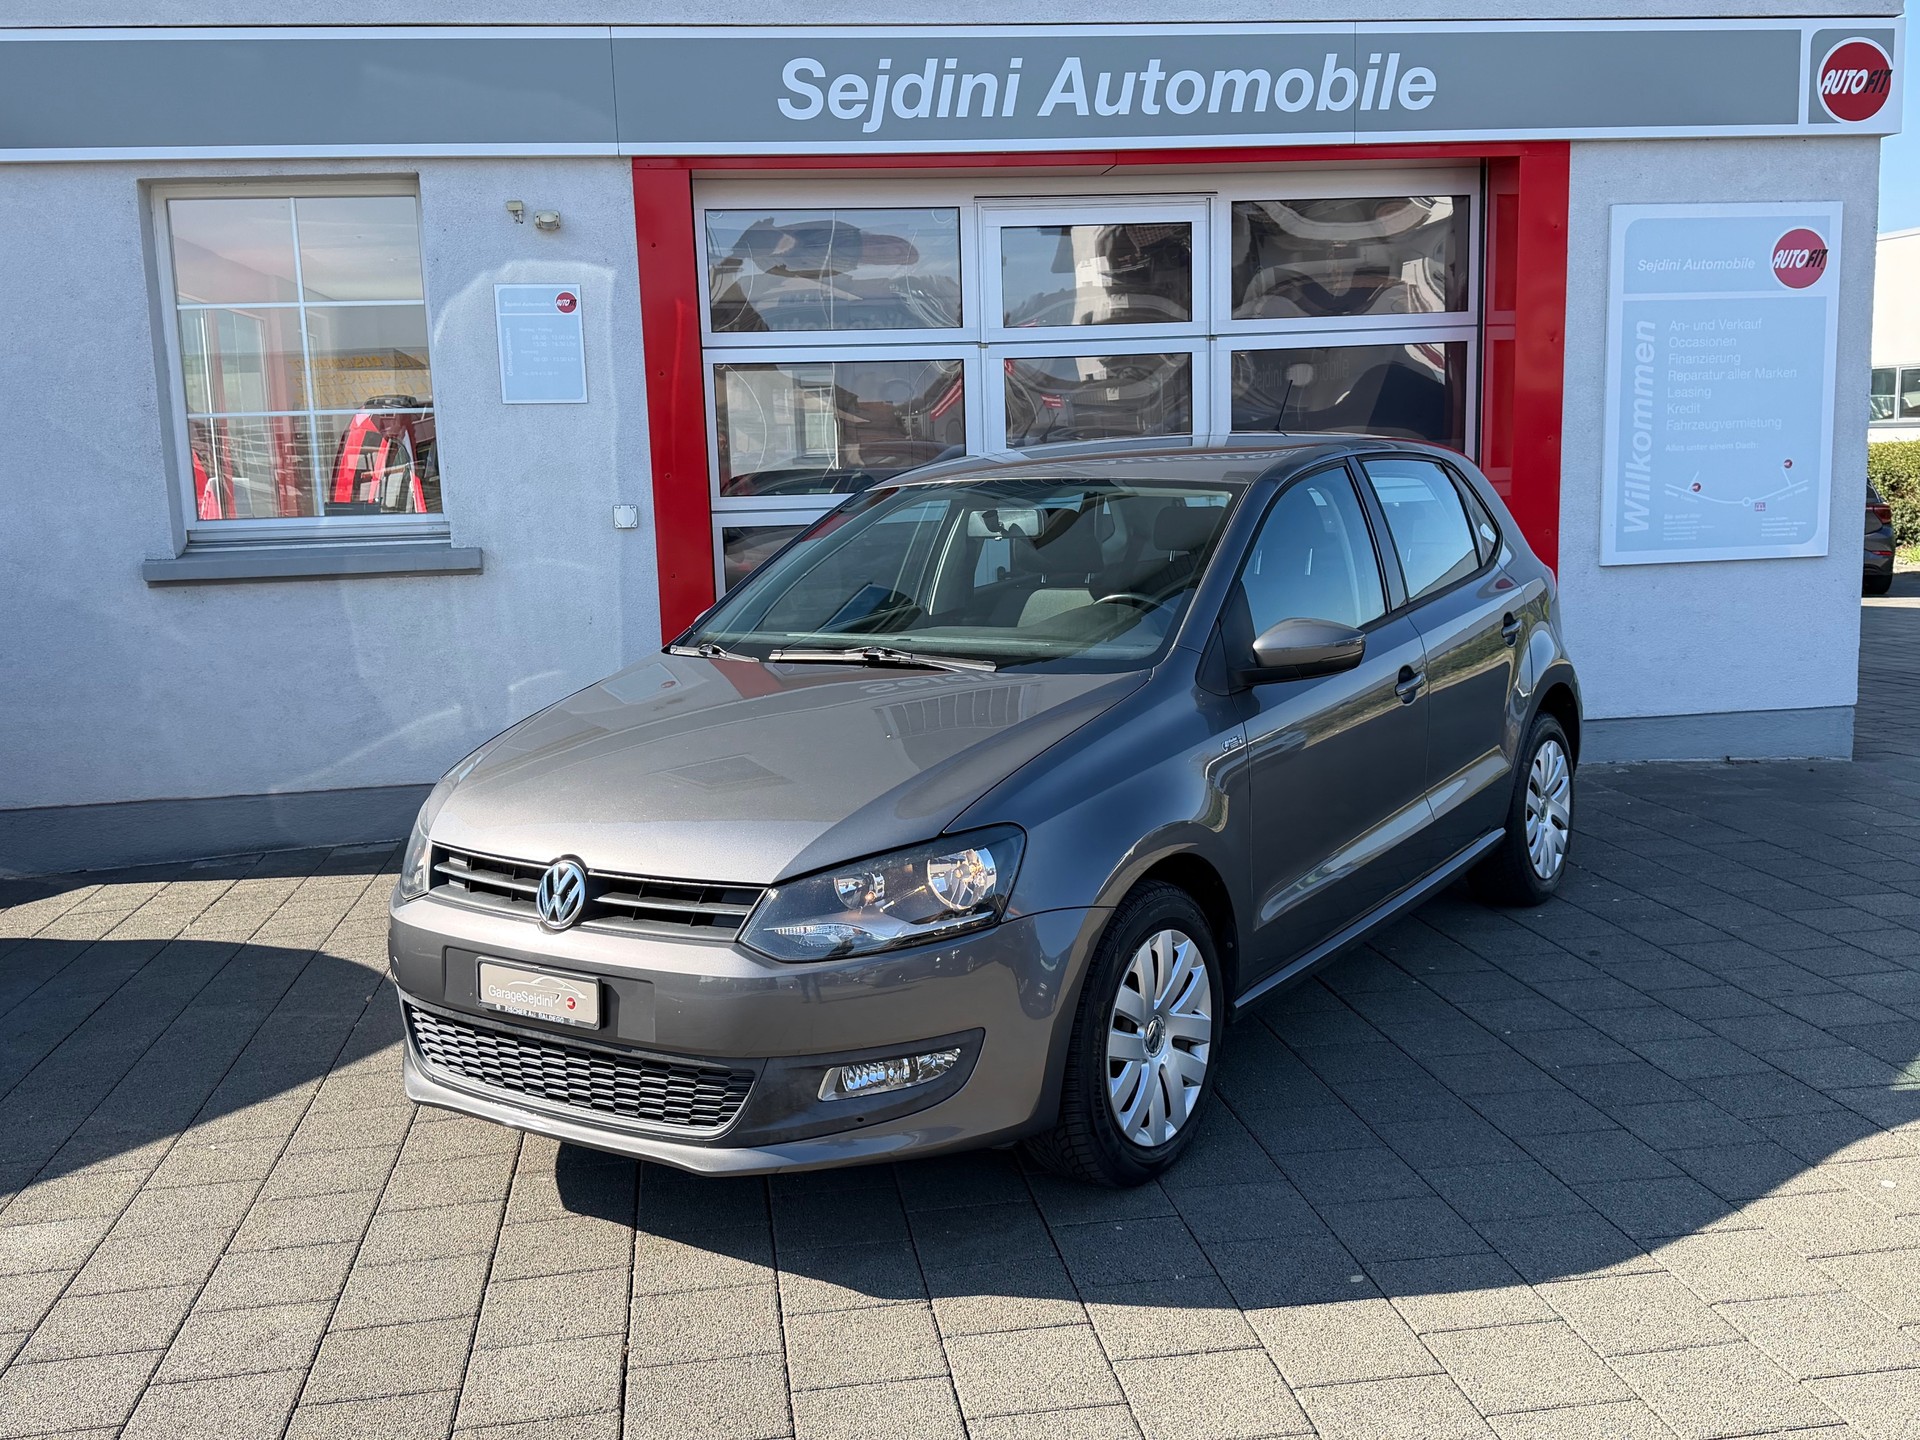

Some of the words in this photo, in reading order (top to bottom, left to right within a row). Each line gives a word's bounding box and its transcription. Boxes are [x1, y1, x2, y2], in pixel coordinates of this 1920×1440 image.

[1821, 69, 1893, 95] AUTOFIT
[777, 57, 1023, 133] Sejdini
[1036, 53, 1437, 117] Automobile
[1638, 259, 1681, 273] Sejdini
[1683, 257, 1756, 271] Automobile
[1773, 249, 1828, 269] AUTOFIT
[1669, 320, 1690, 331] An-
[1693, 319, 1716, 331] und
[1719, 318, 1763, 330] Verkauf
[1669, 336, 1737, 348] Occasionen
[1668, 353, 1741, 365] Finanzierung
[1668, 369, 1725, 383] Reparatur
[1727, 368, 1752, 380] aller
[1755, 367, 1798, 379] Marken
[1667, 387, 1712, 399] Leasing
[1667, 403, 1701, 415] Kredit
[1623, 320, 1656, 533] Willkommen
[1666, 418, 1783, 432] Fahrzeugvermietung
[538, 862, 585, 928] VW
[488, 984, 554, 1008] GarageSejdini
